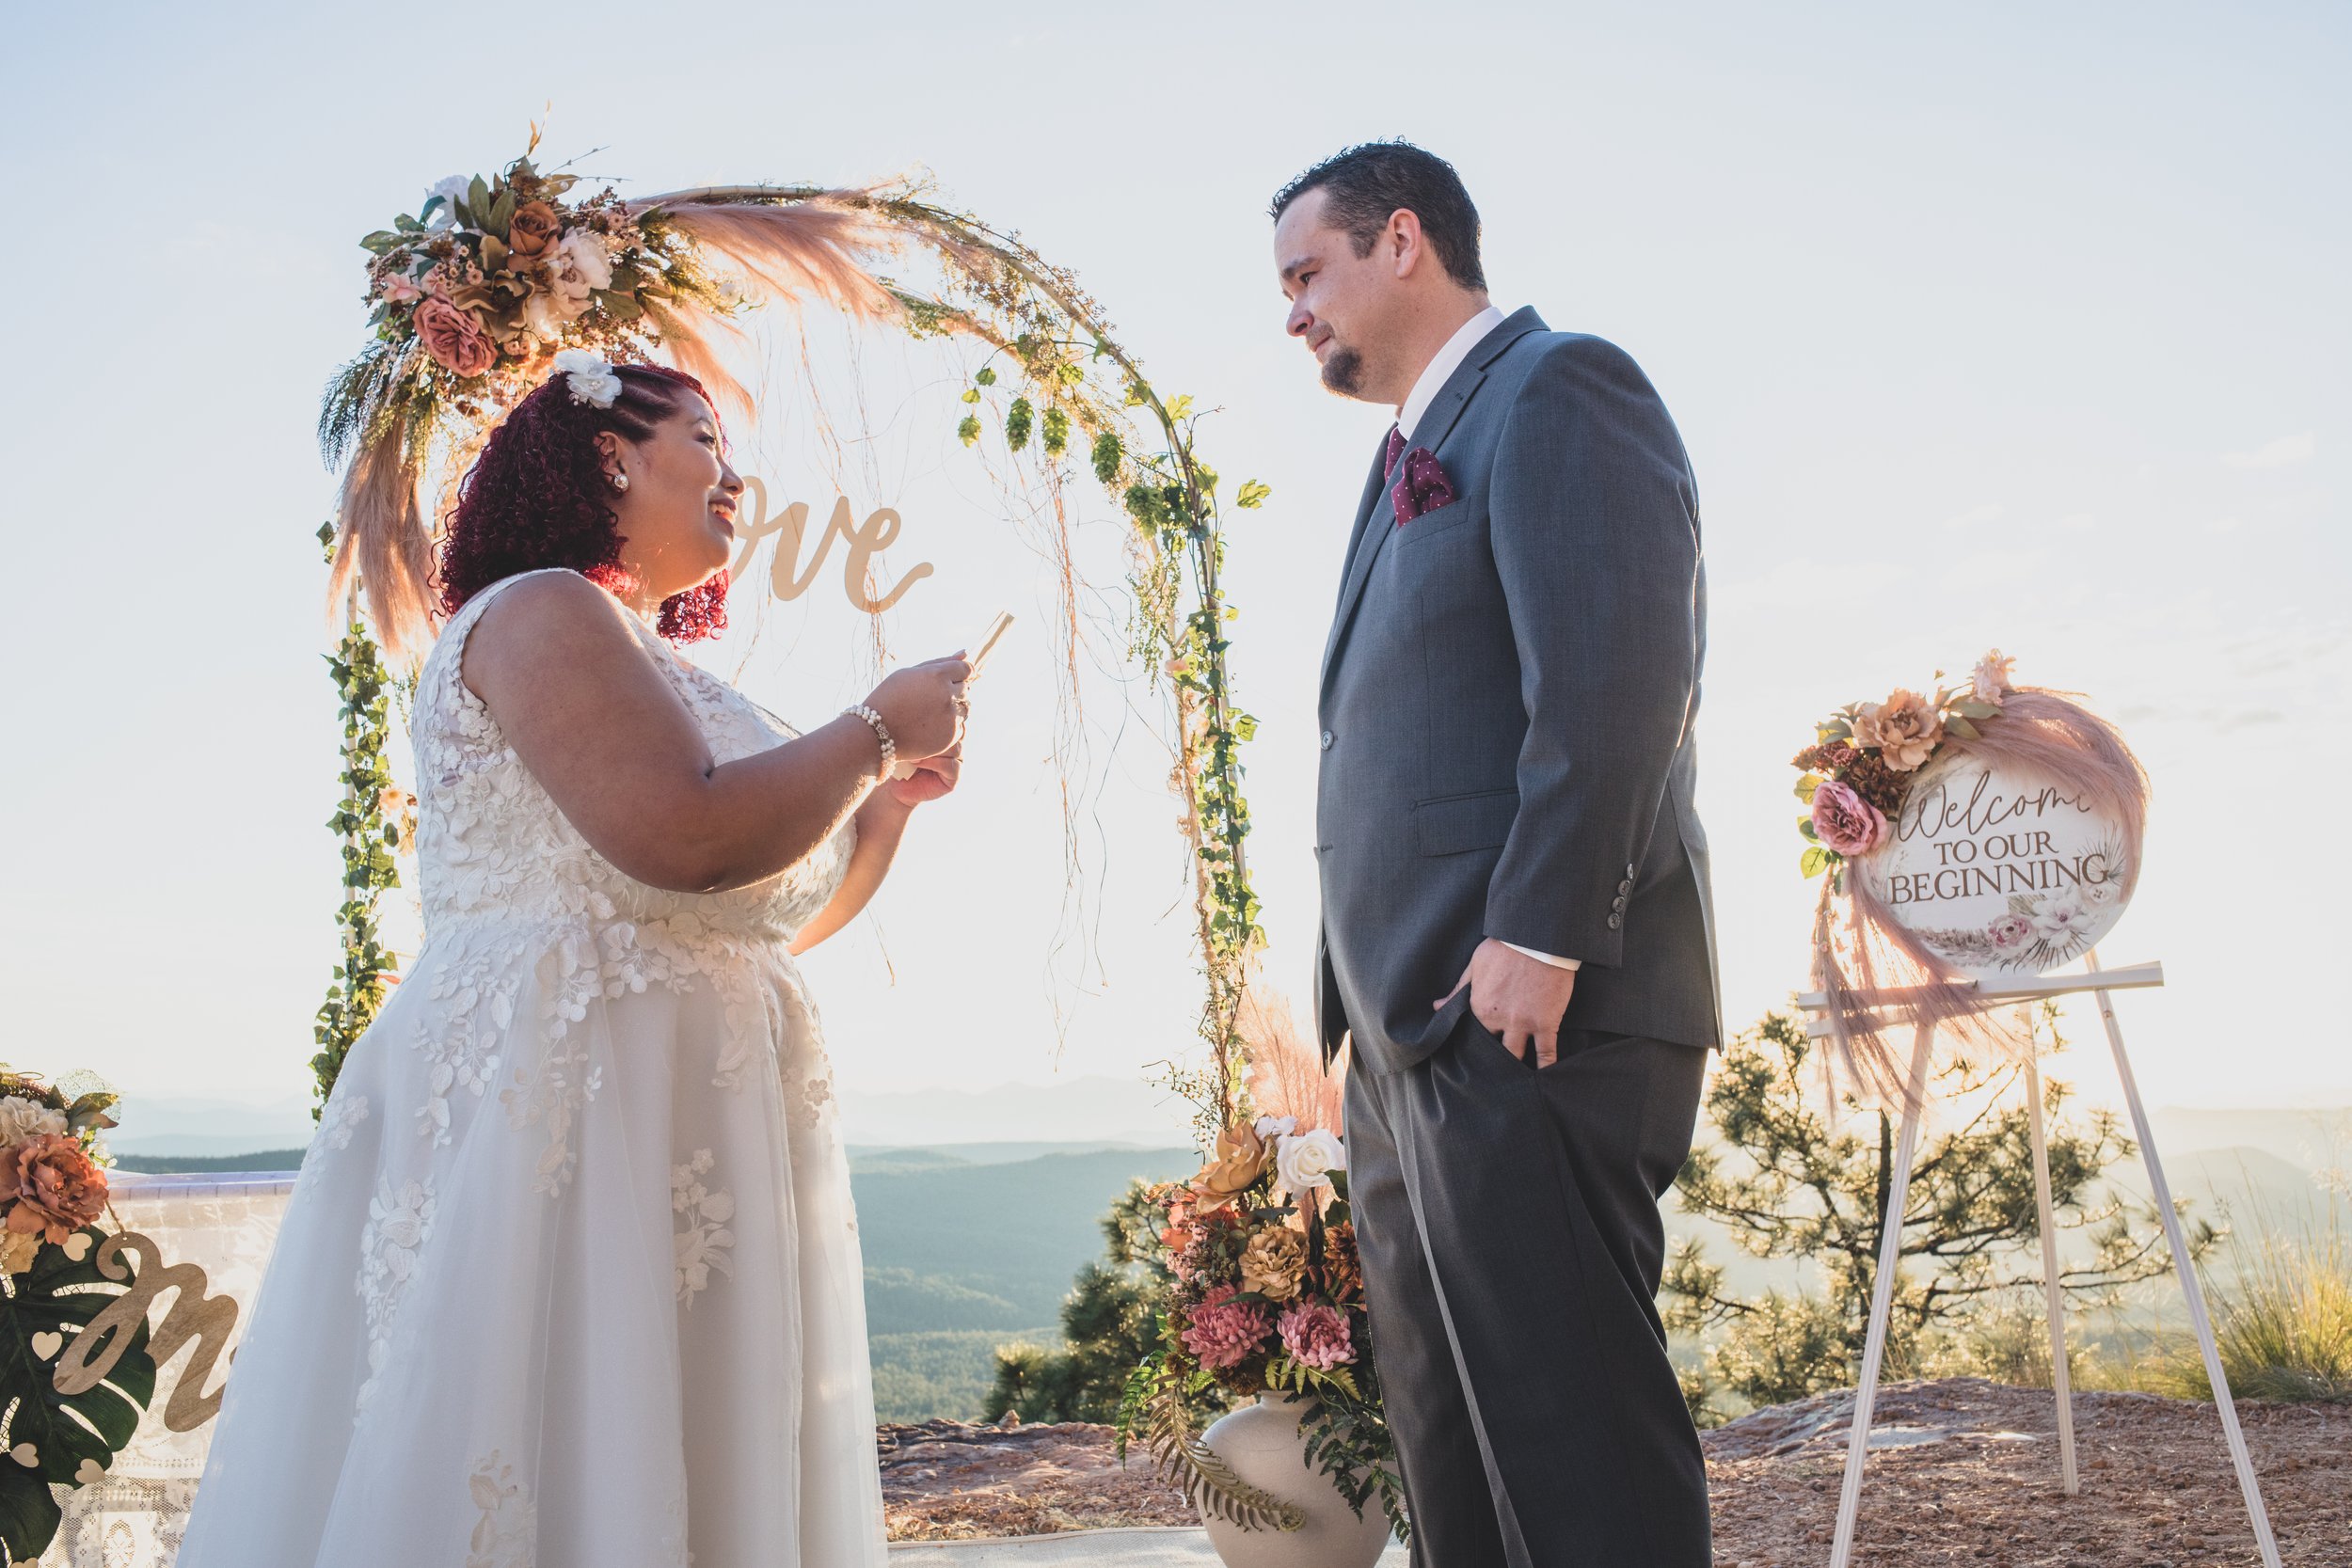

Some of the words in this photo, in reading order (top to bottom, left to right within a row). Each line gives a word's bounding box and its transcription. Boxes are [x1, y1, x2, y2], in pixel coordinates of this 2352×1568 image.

[729, 475, 934, 613] ove
[1933, 838, 1978, 865] TO
[1984, 831, 2059, 861] OUR
[1889, 853, 2109, 905] BEGINNING
